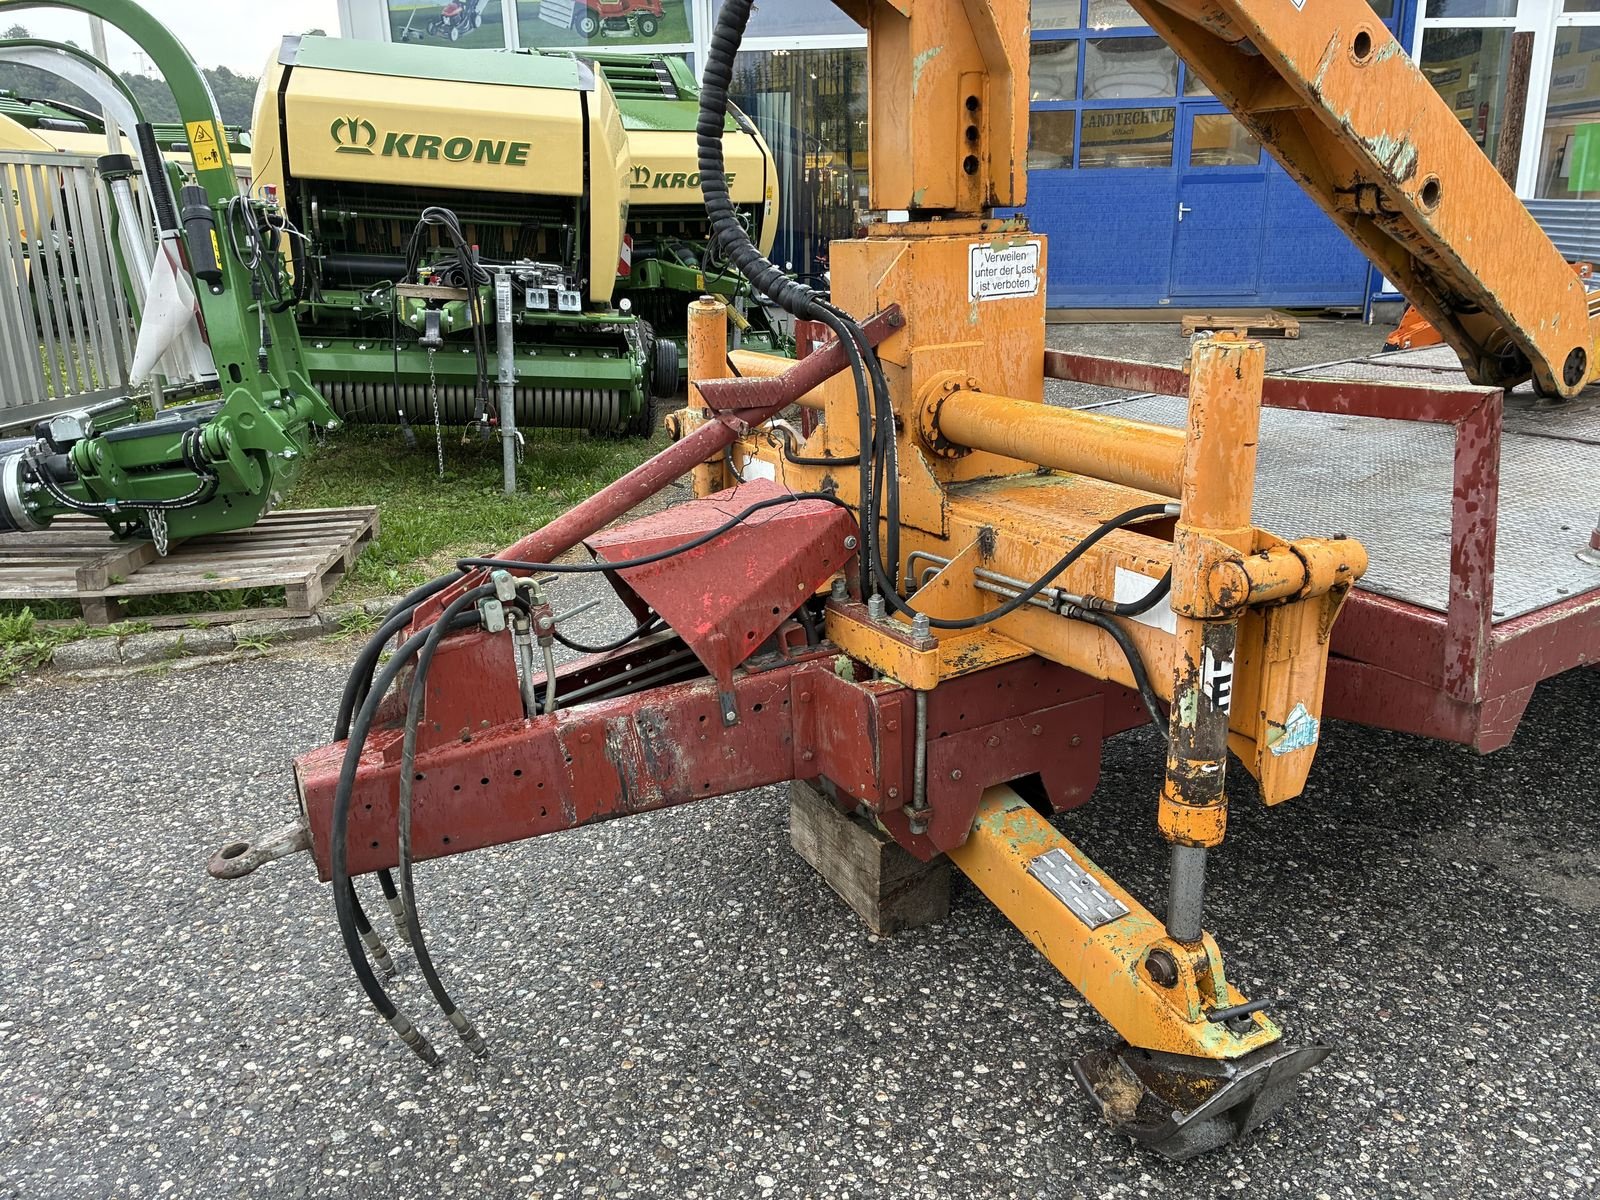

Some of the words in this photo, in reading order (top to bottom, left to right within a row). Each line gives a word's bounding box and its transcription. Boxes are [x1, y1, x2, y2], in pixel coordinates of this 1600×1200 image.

[381, 131, 532, 166] KRONE
[652, 172, 737, 189] KROE
[984, 250, 1027, 263] Verweilen
[974, 267, 997, 278] unter
[999, 265, 1014, 276] der
[1015, 263, 1034, 275] Last
[979, 281, 990, 291] ist
[992, 279, 1030, 290] verboten
